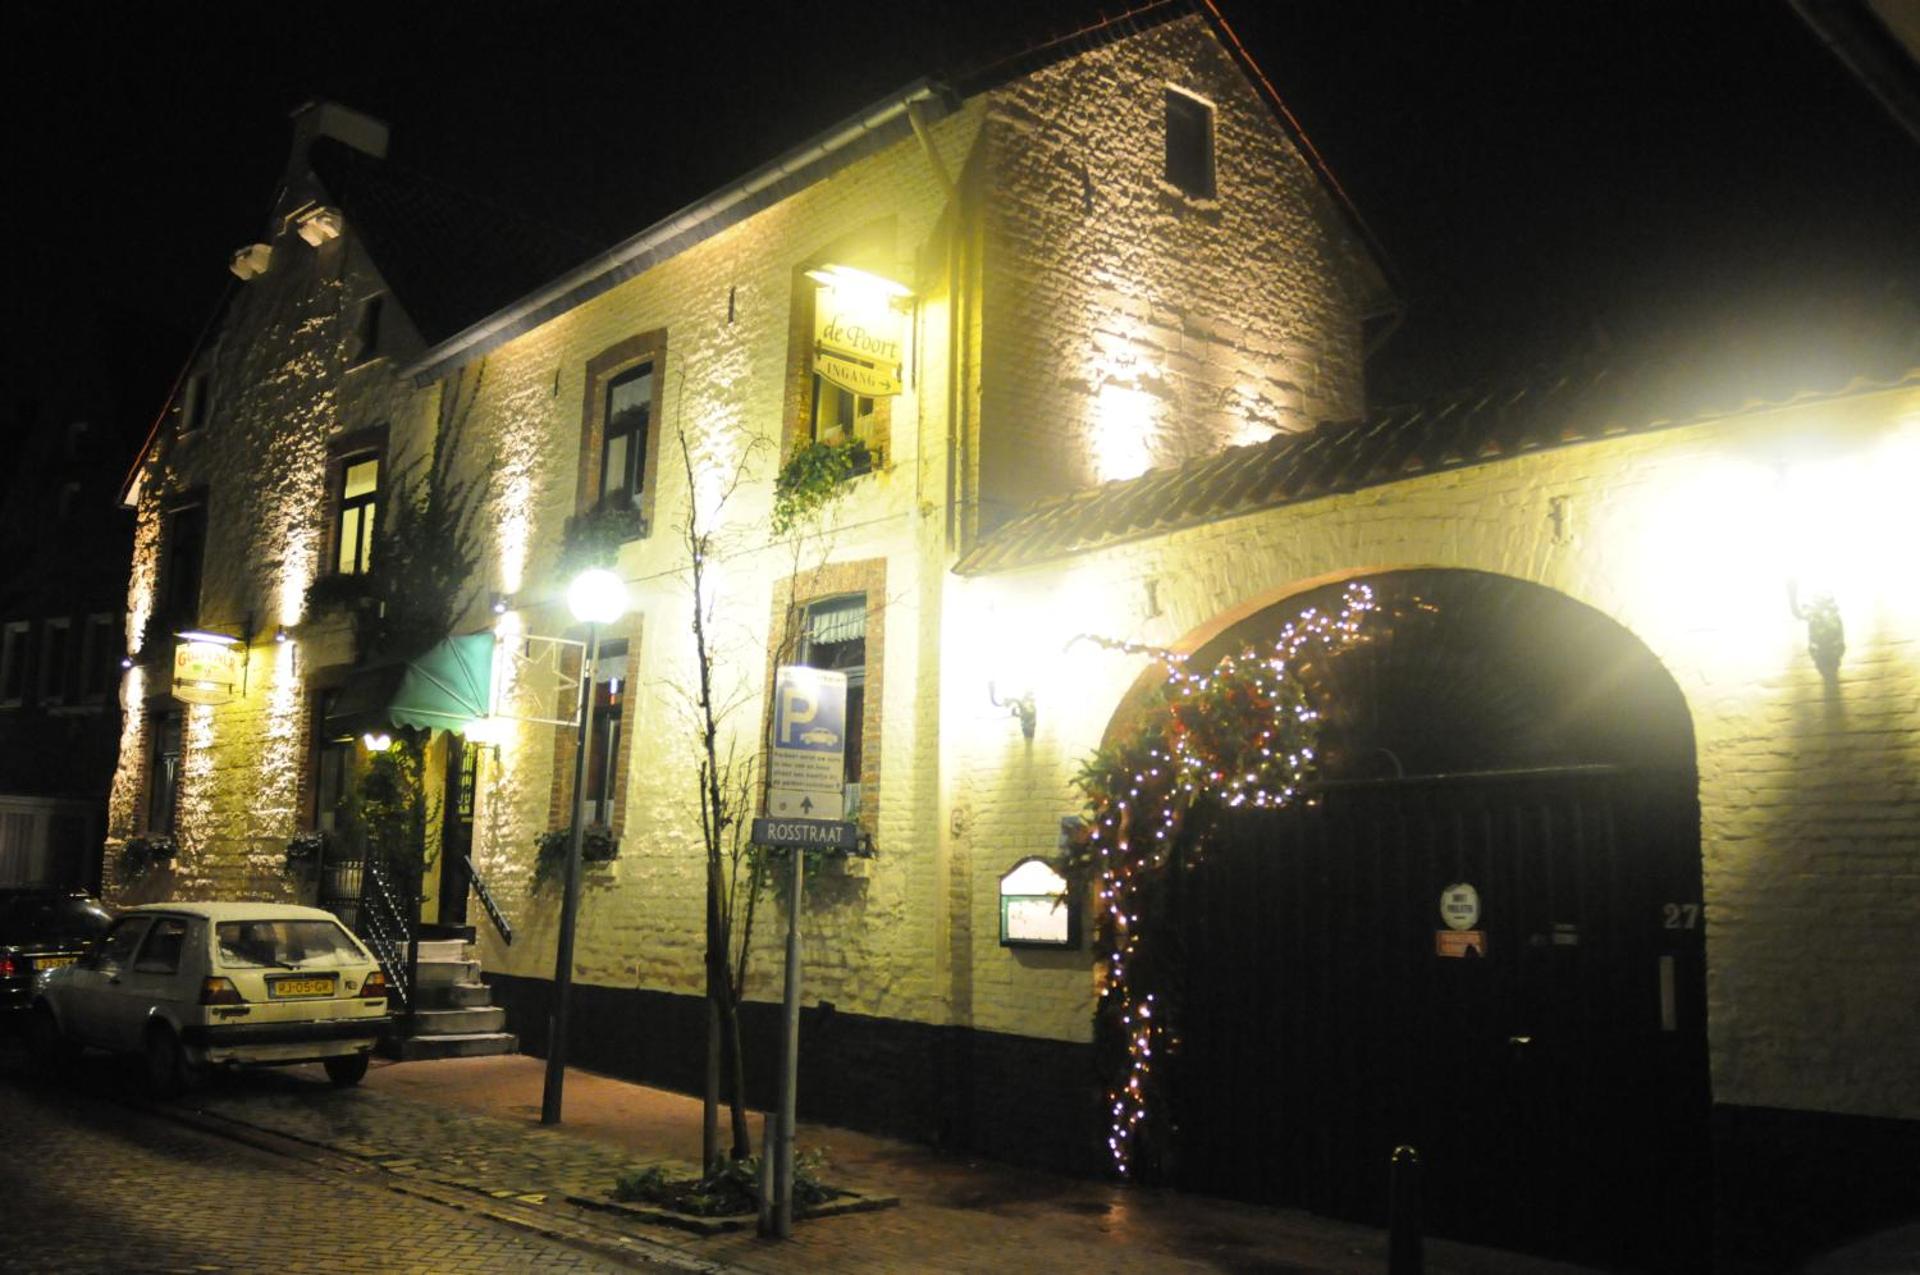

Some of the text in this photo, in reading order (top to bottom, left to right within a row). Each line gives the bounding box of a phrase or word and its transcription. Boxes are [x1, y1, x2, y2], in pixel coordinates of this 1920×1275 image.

[823, 316, 898, 359] de Poort
[826, 362, 876, 387] INGANG
[781, 686, 818, 743] P
[767, 822, 844, 843] ROSSTRAAT
[1664, 902, 1699, 929] 27
